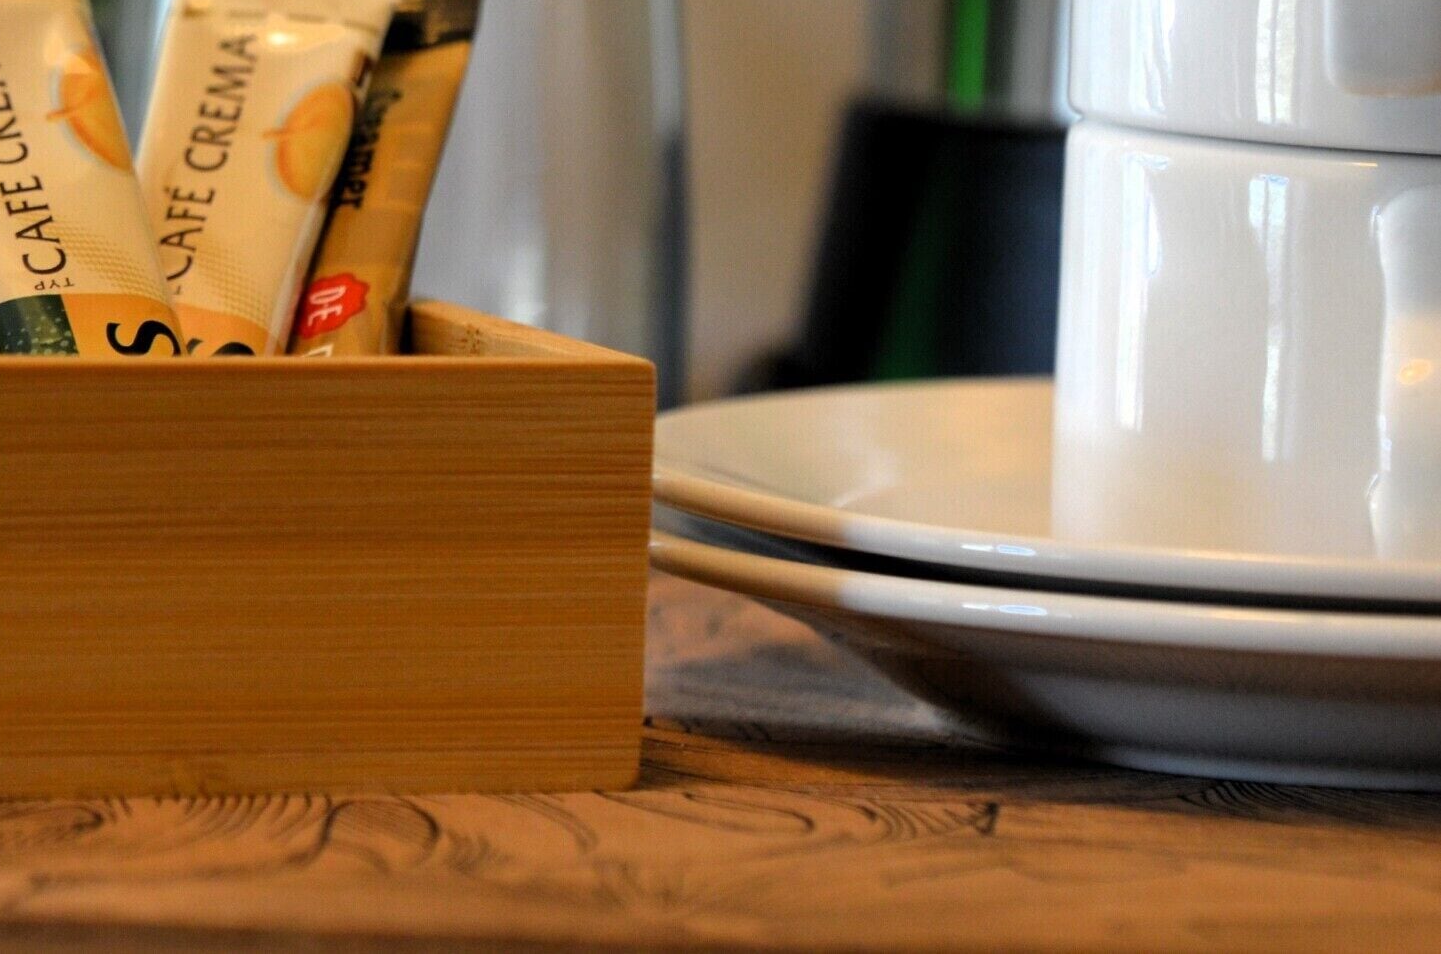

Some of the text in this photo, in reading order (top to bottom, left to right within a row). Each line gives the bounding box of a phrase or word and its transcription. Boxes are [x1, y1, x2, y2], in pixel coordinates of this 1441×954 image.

[160, 35, 258, 281] CAFÉ CREMA
[34, 277, 75, 291] TYP
